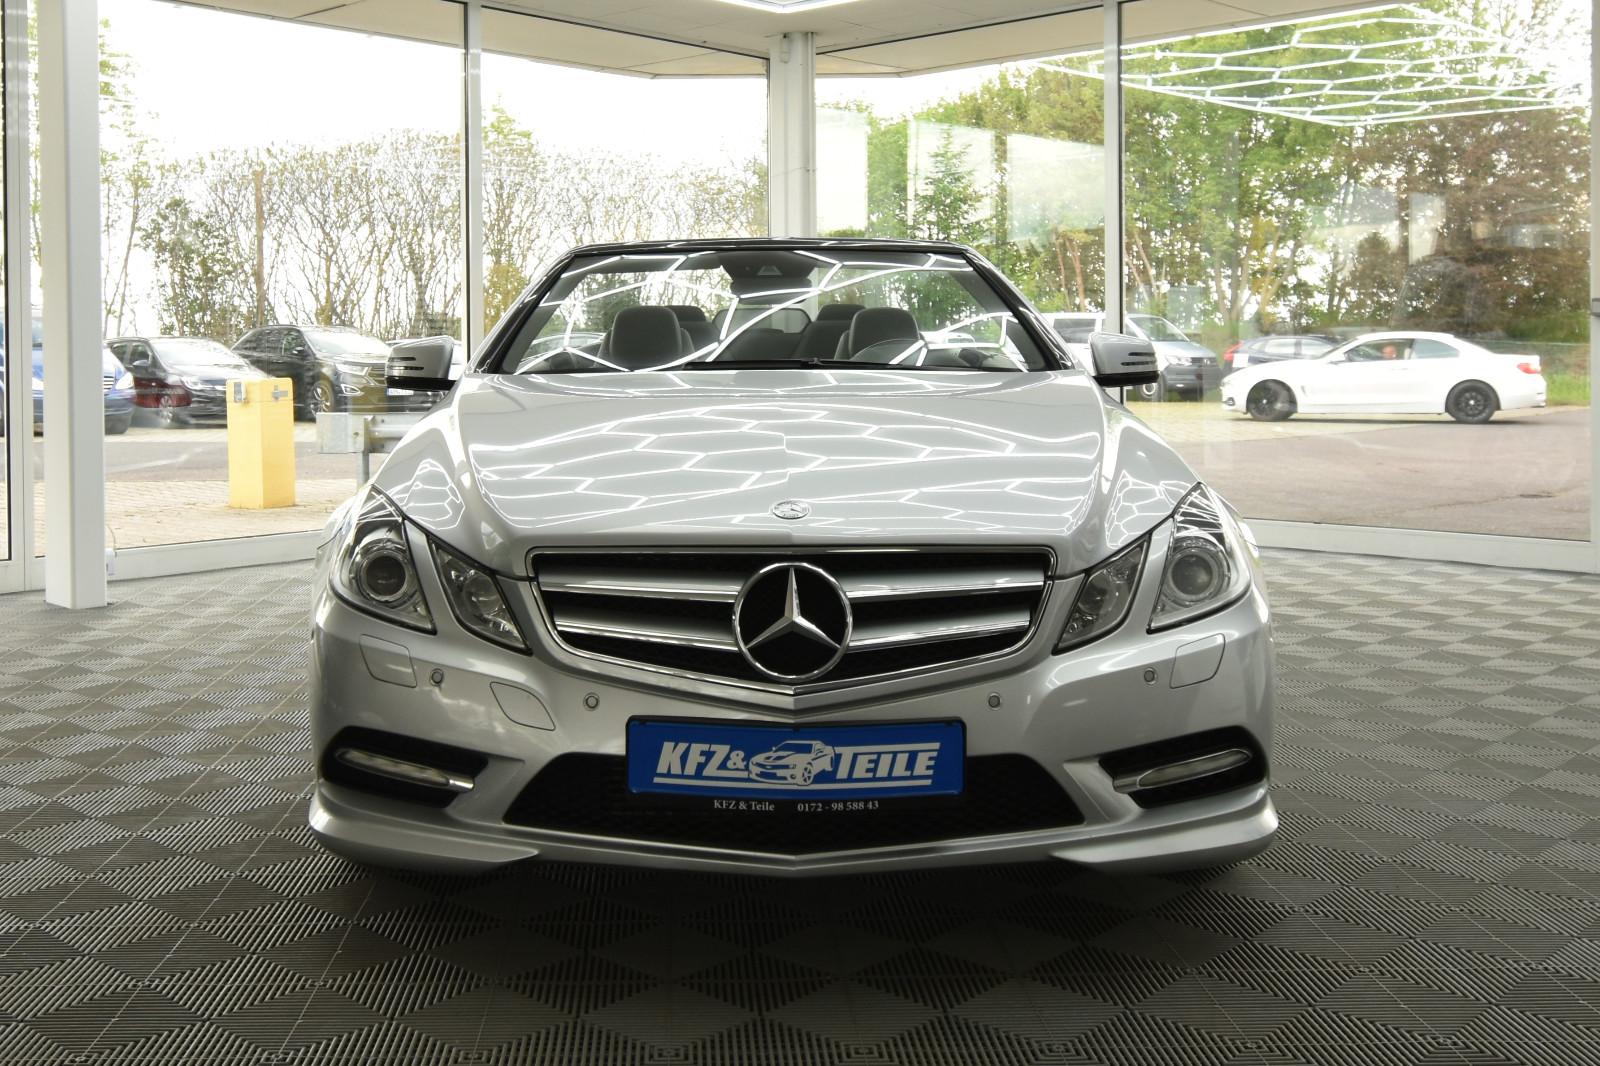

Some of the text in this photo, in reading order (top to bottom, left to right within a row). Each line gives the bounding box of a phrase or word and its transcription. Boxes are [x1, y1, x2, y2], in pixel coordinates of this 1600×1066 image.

[834, 743, 941, 780] TEILE
[713, 799, 737, 810] KFZ
[738, 801, 748, 810] &
[750, 801, 775, 812] Teile
[797, 802, 823, 812] 0172
[831, 801, 844, 811] 98
[845, 801, 865, 811] 588
[866, 800, 879, 811] 43
